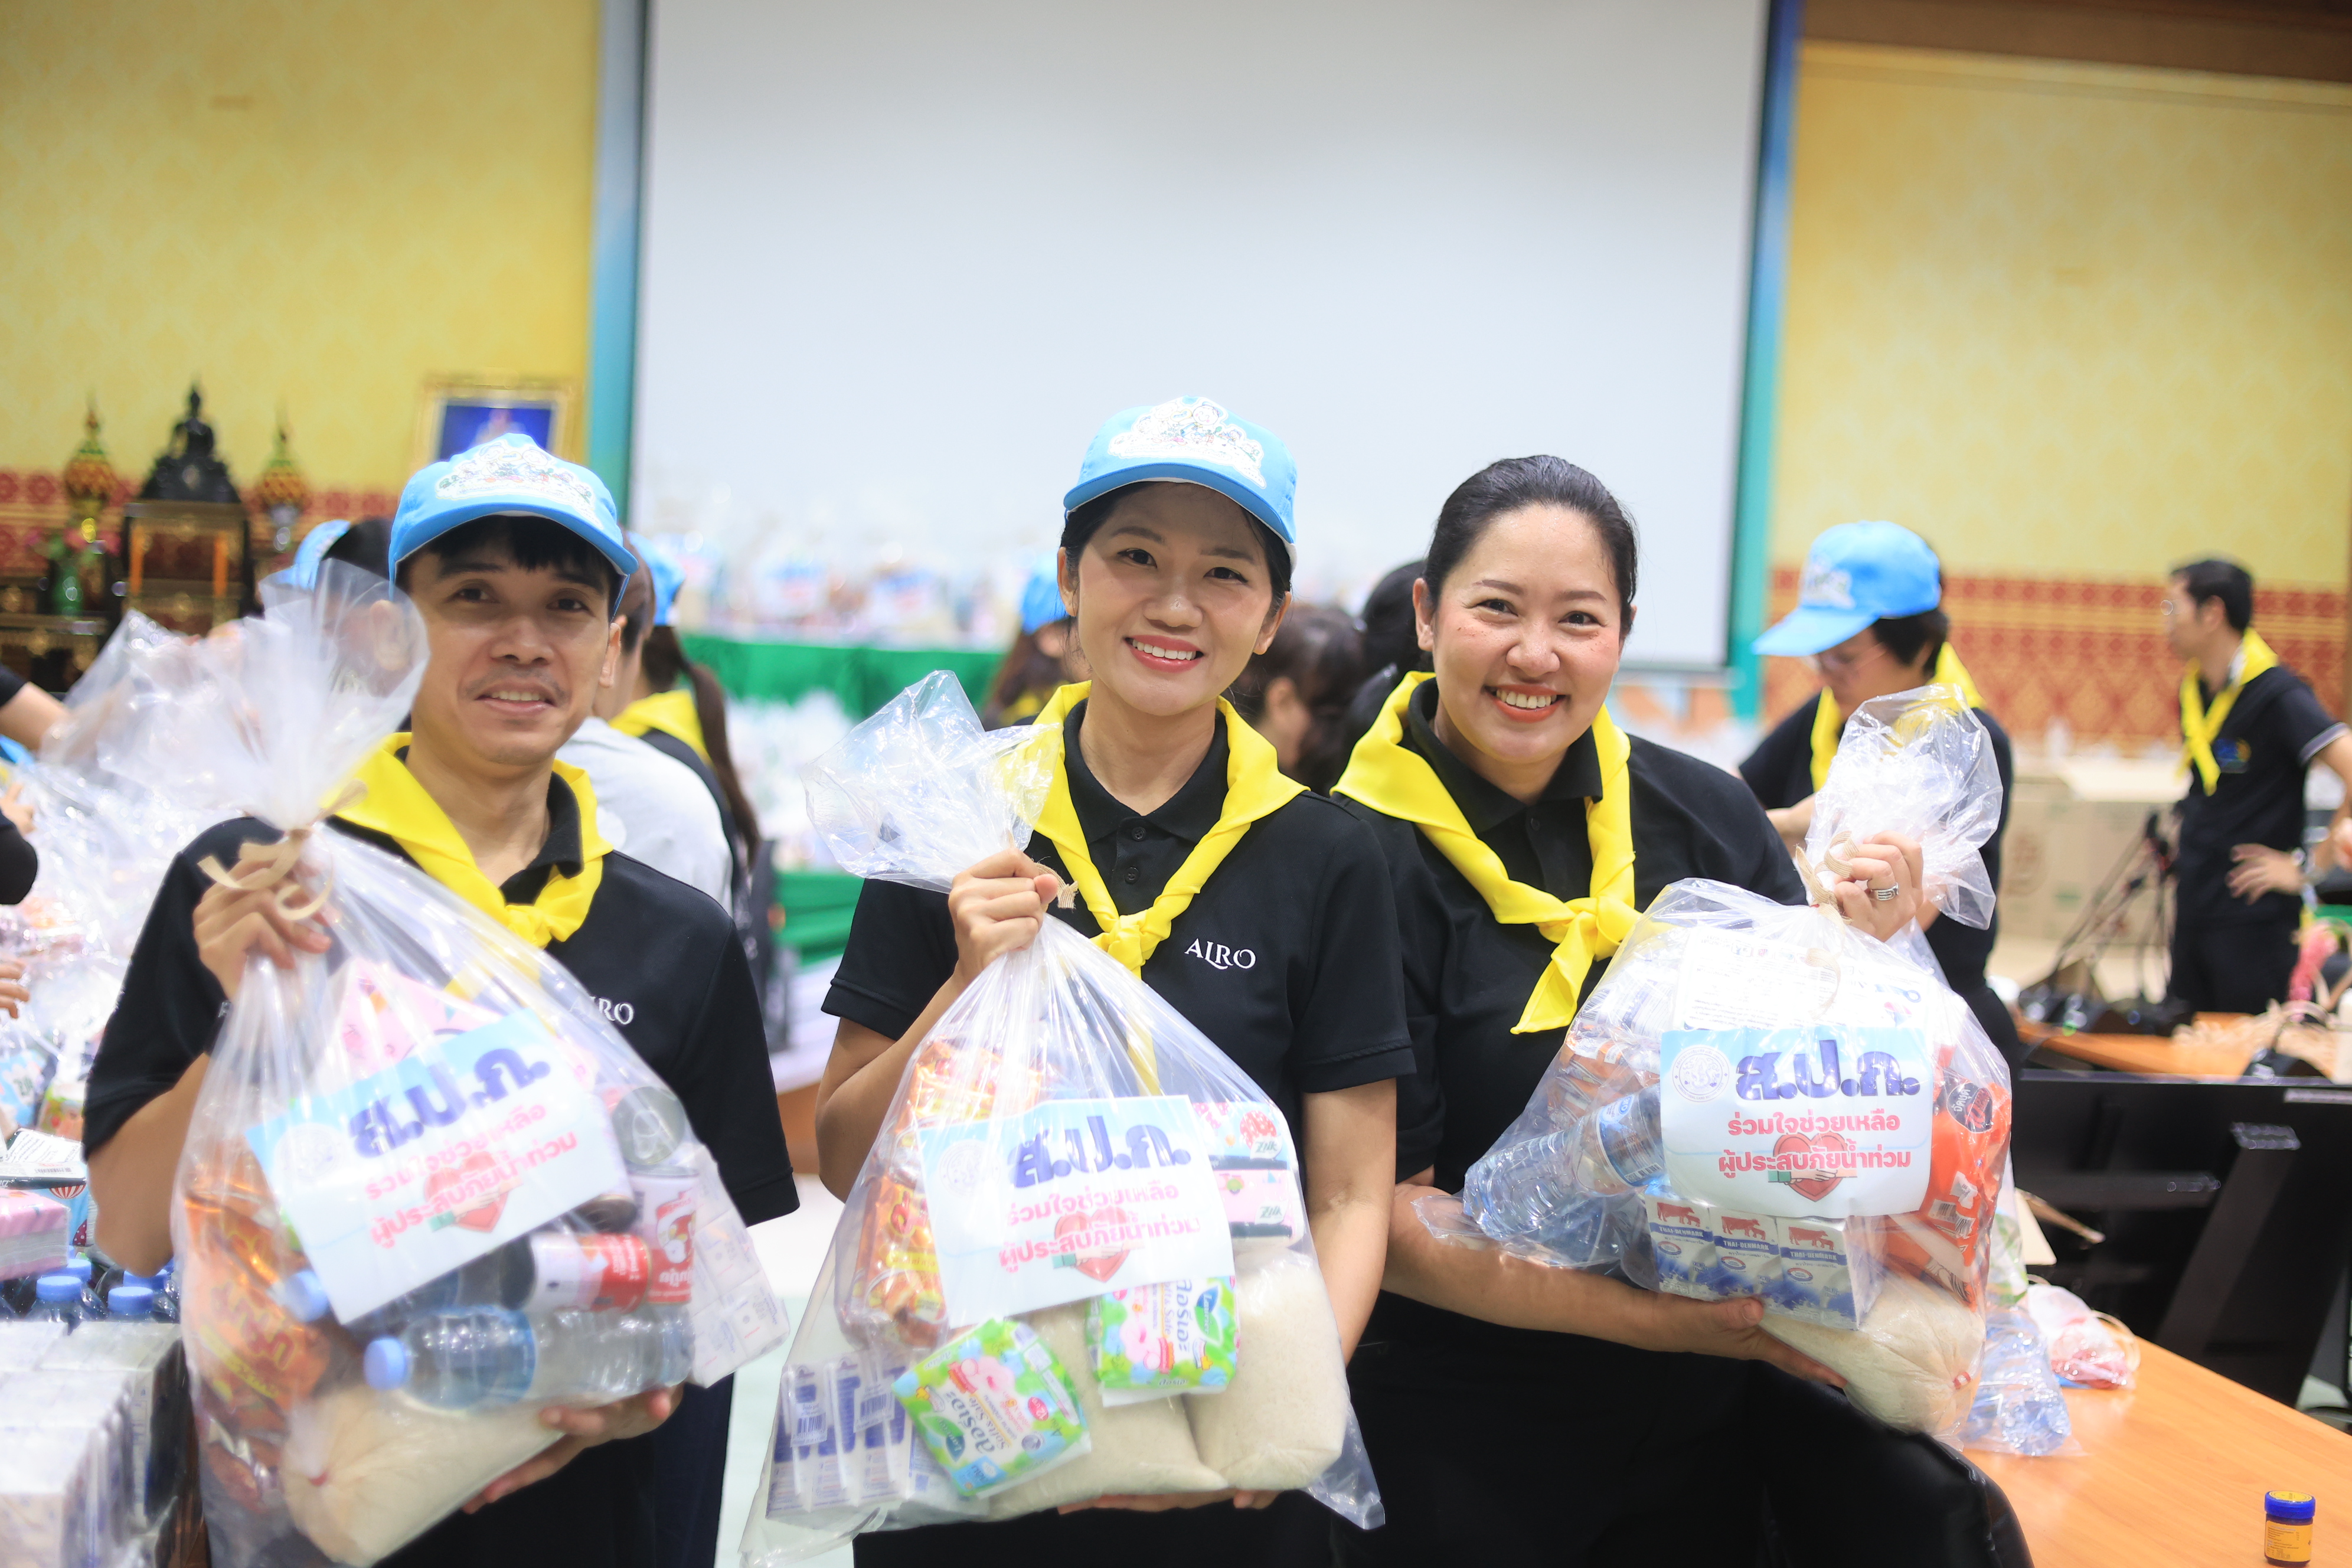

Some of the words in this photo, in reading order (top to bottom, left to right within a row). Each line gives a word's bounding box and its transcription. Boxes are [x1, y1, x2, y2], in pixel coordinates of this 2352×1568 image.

[1184, 938, 1256, 969] ALRO
[1736, 1040, 1920, 1100] ส.ป.ก.
[349, 1048, 551, 1159] ส.ป.ก.
[1727, 1108, 1901, 1136] ร่วมใจช่วยเหลือ
[1007, 1116, 1191, 1188] ส.ป.ก.
[1718, 1138, 1912, 1179] ผู้ประสบภัยน้ำท่วม
[1723, 1240, 1770, 1251] THAI-DENMARK
[1203, 1293, 1213, 1334] Laurier
